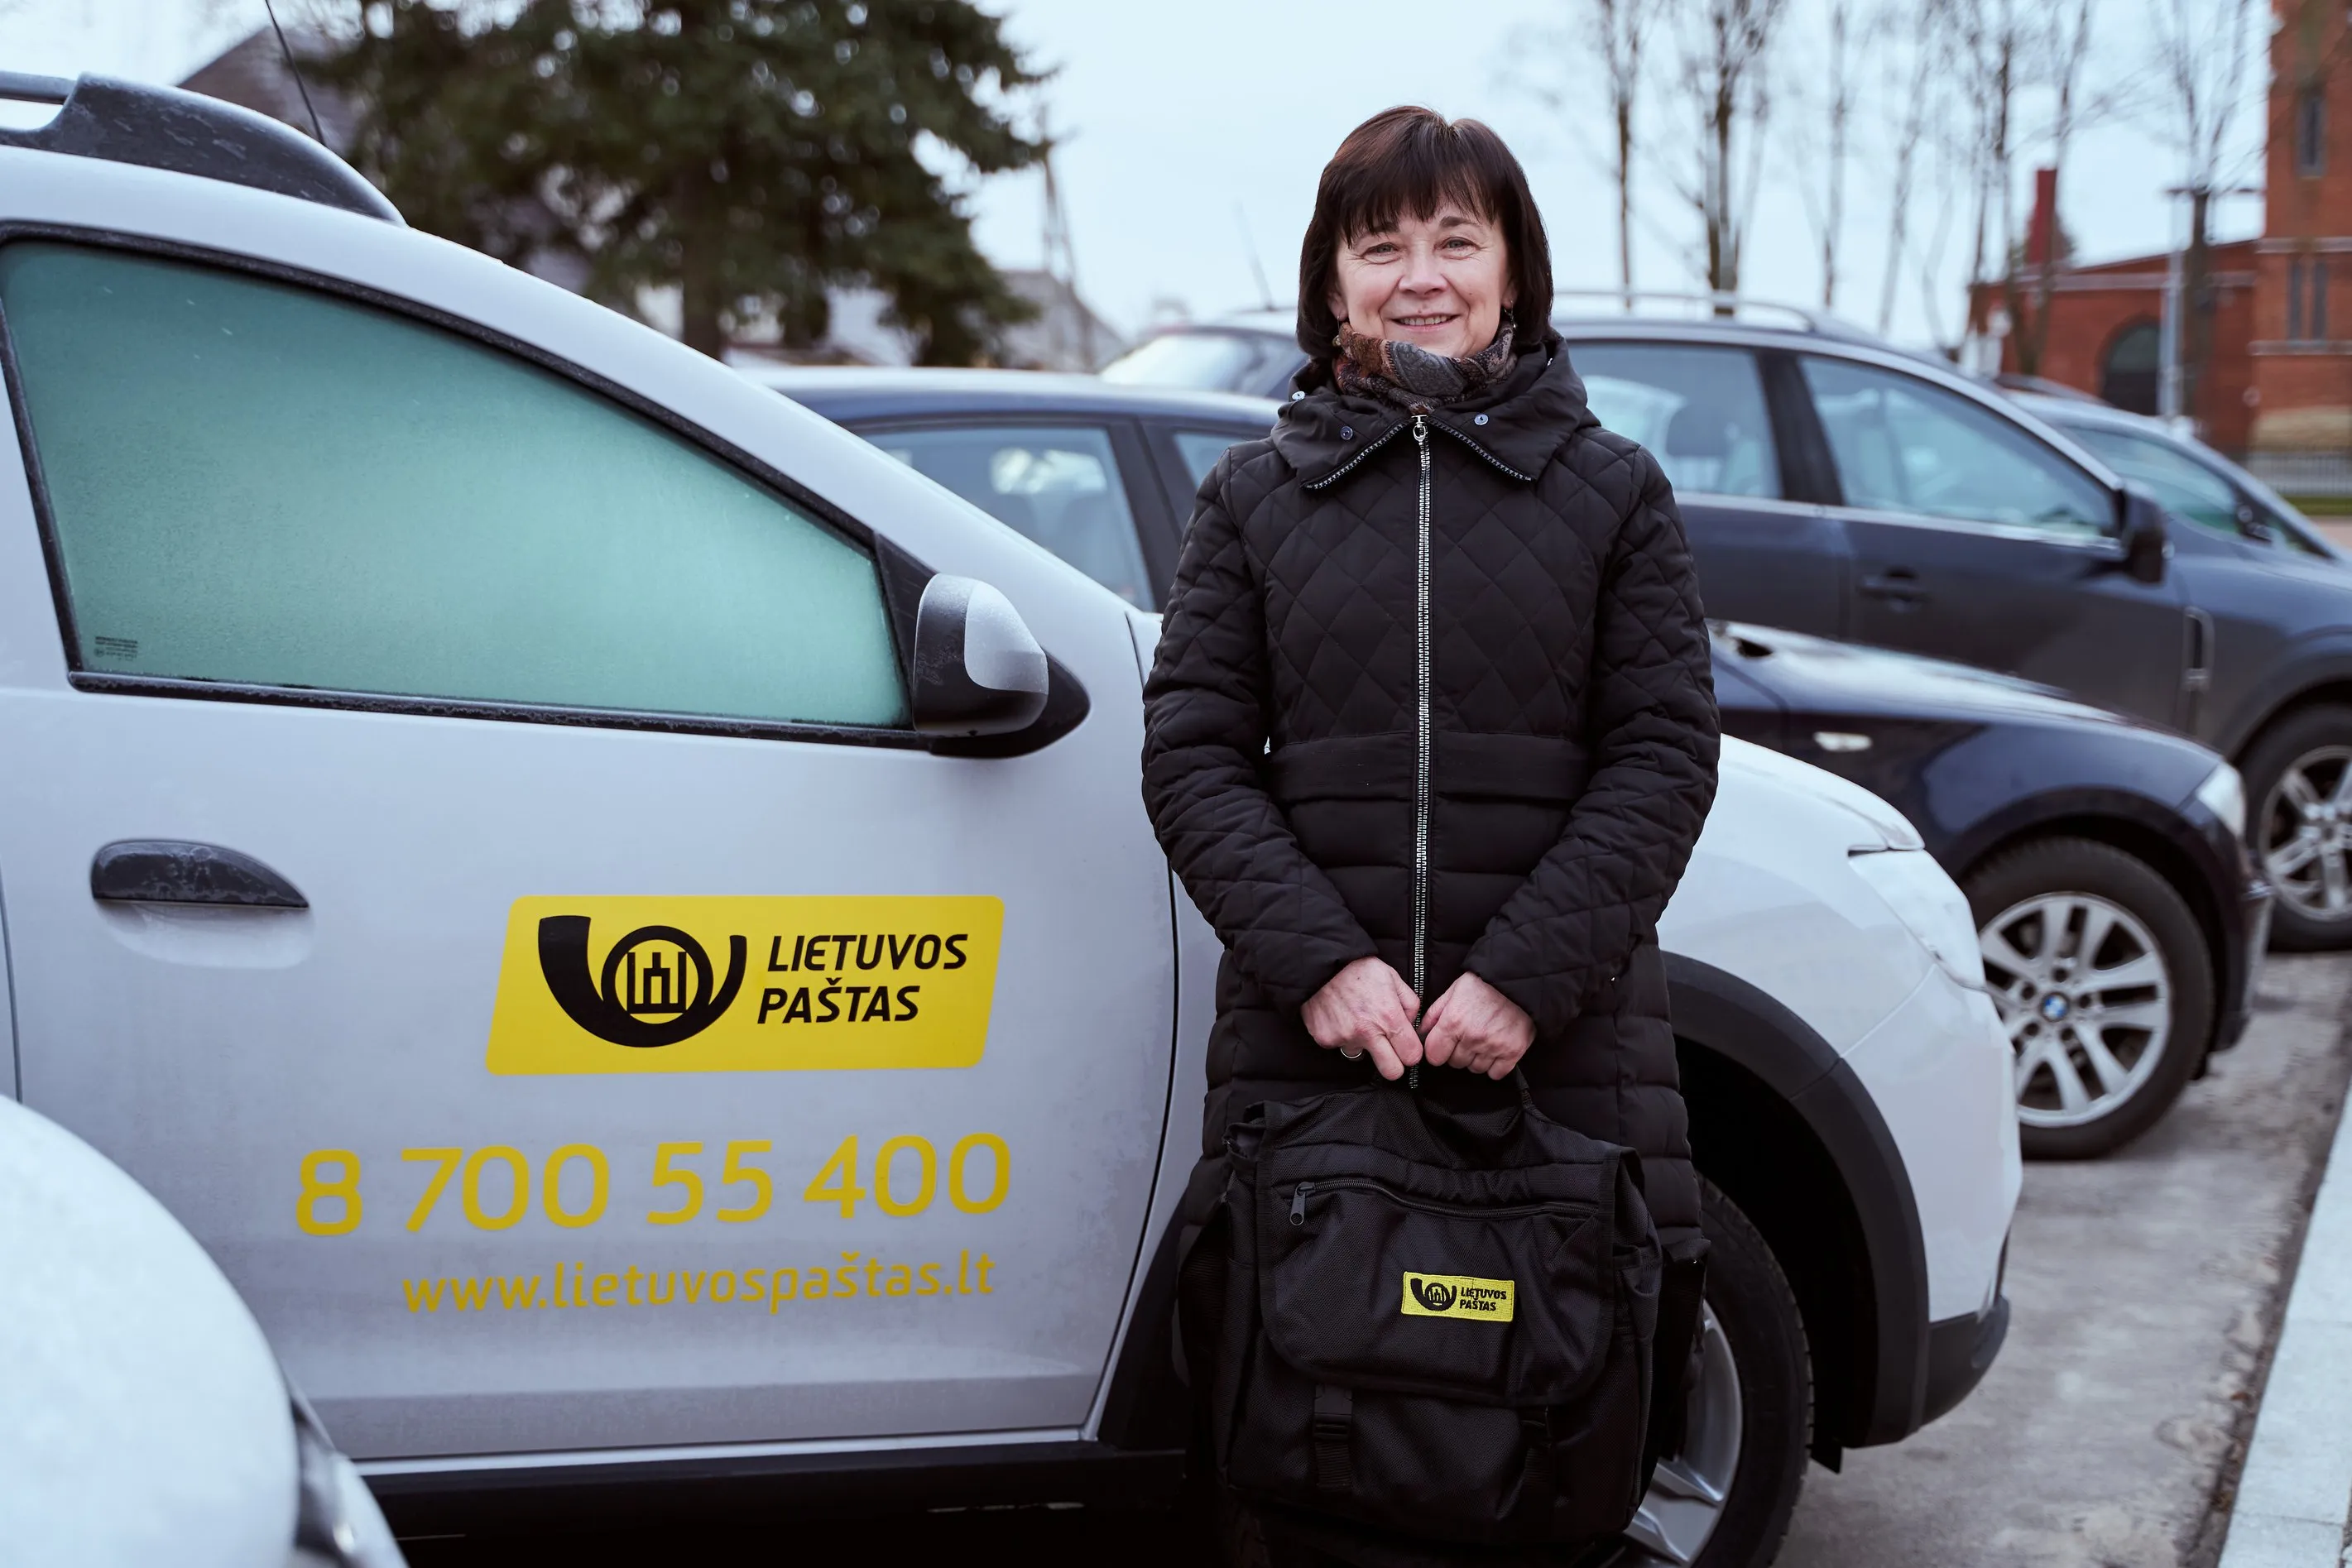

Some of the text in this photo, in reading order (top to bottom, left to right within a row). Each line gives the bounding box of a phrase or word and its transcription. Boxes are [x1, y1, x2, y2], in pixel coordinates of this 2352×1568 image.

[767, 933, 968, 972] LIETUVOS
[757, 977, 921, 1024] PAŠTAS
[295, 1133, 1010, 1236] 8 700 55 400
[402, 1249, 996, 1315] www.lietuvospaštas.lt
[1460, 1287, 1507, 1300] LIETUVOS
[1459, 1297, 1497, 1311] PAŠTAS
